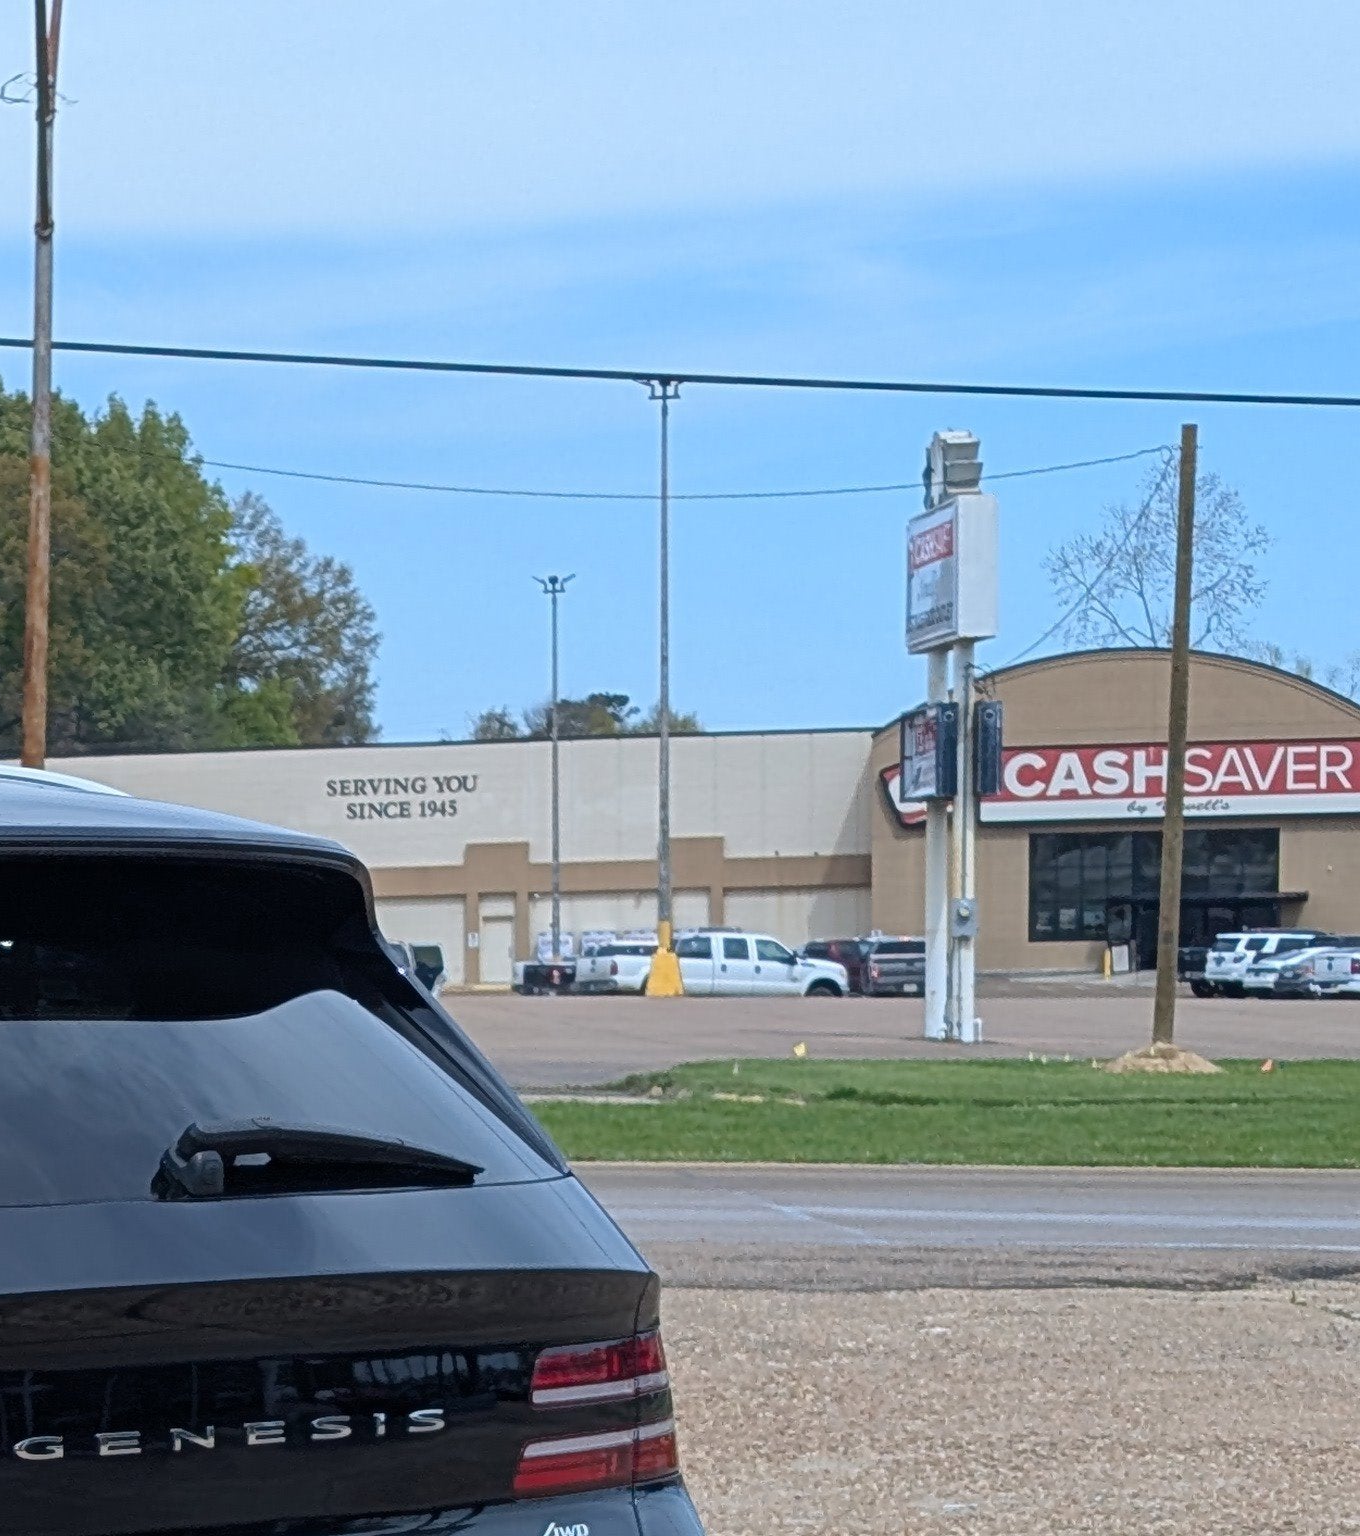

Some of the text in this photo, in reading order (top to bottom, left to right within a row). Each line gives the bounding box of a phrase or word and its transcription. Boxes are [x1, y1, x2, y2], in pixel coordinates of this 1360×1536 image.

[326, 775, 479, 797] SERVING YOU
[1003, 745, 1354, 797] CASH SAVER
[346, 799, 458, 820] SINCE 1945
[13, 1408, 446, 1461] GENESIS
